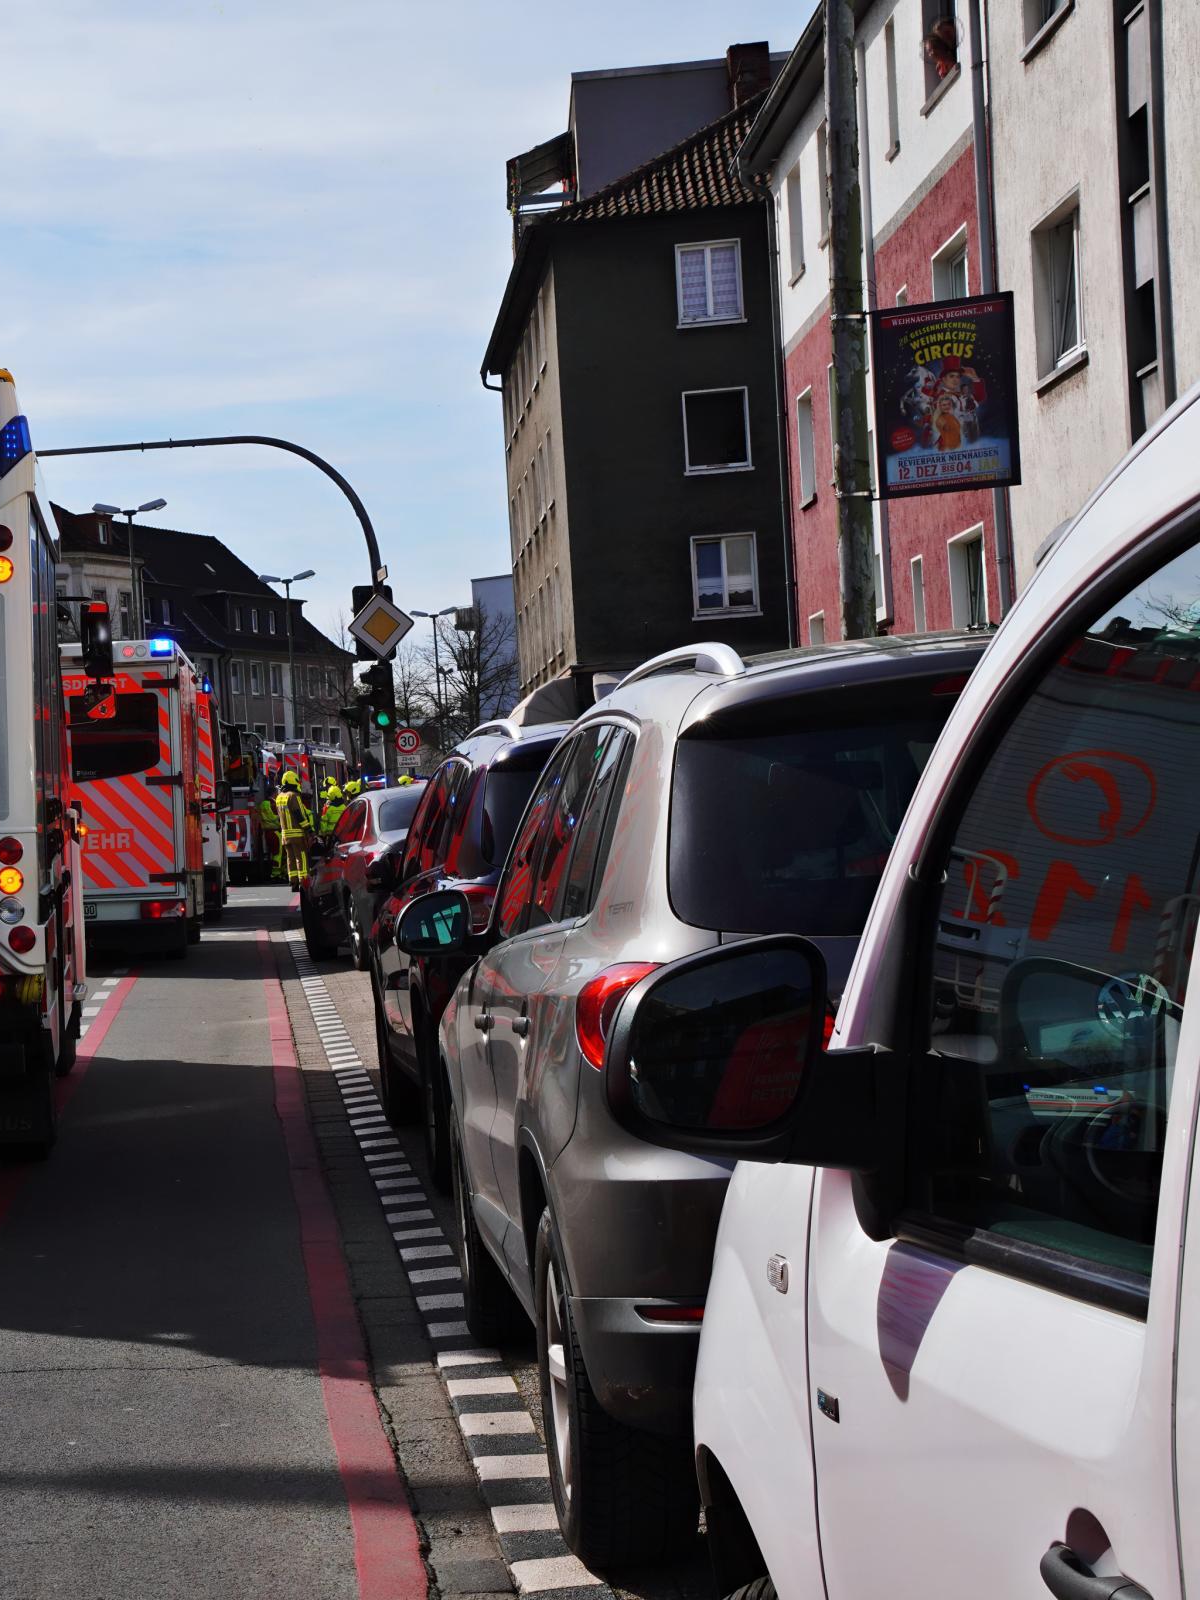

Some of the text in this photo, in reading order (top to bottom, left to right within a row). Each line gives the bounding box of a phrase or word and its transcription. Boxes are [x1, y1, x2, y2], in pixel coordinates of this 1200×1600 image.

[891, 313, 945, 327] WEIHNACHTEN
[911, 322, 976, 339] GELSENKIRCHENER
[911, 331, 976, 350] WEIHNACHTS
[914, 343, 974, 365] CIRCUS
[898, 449, 999, 468] REVIERPARK NIENHAUSEN
[941, 465, 955, 473] BIS
[400, 735, 415, 748] 30
